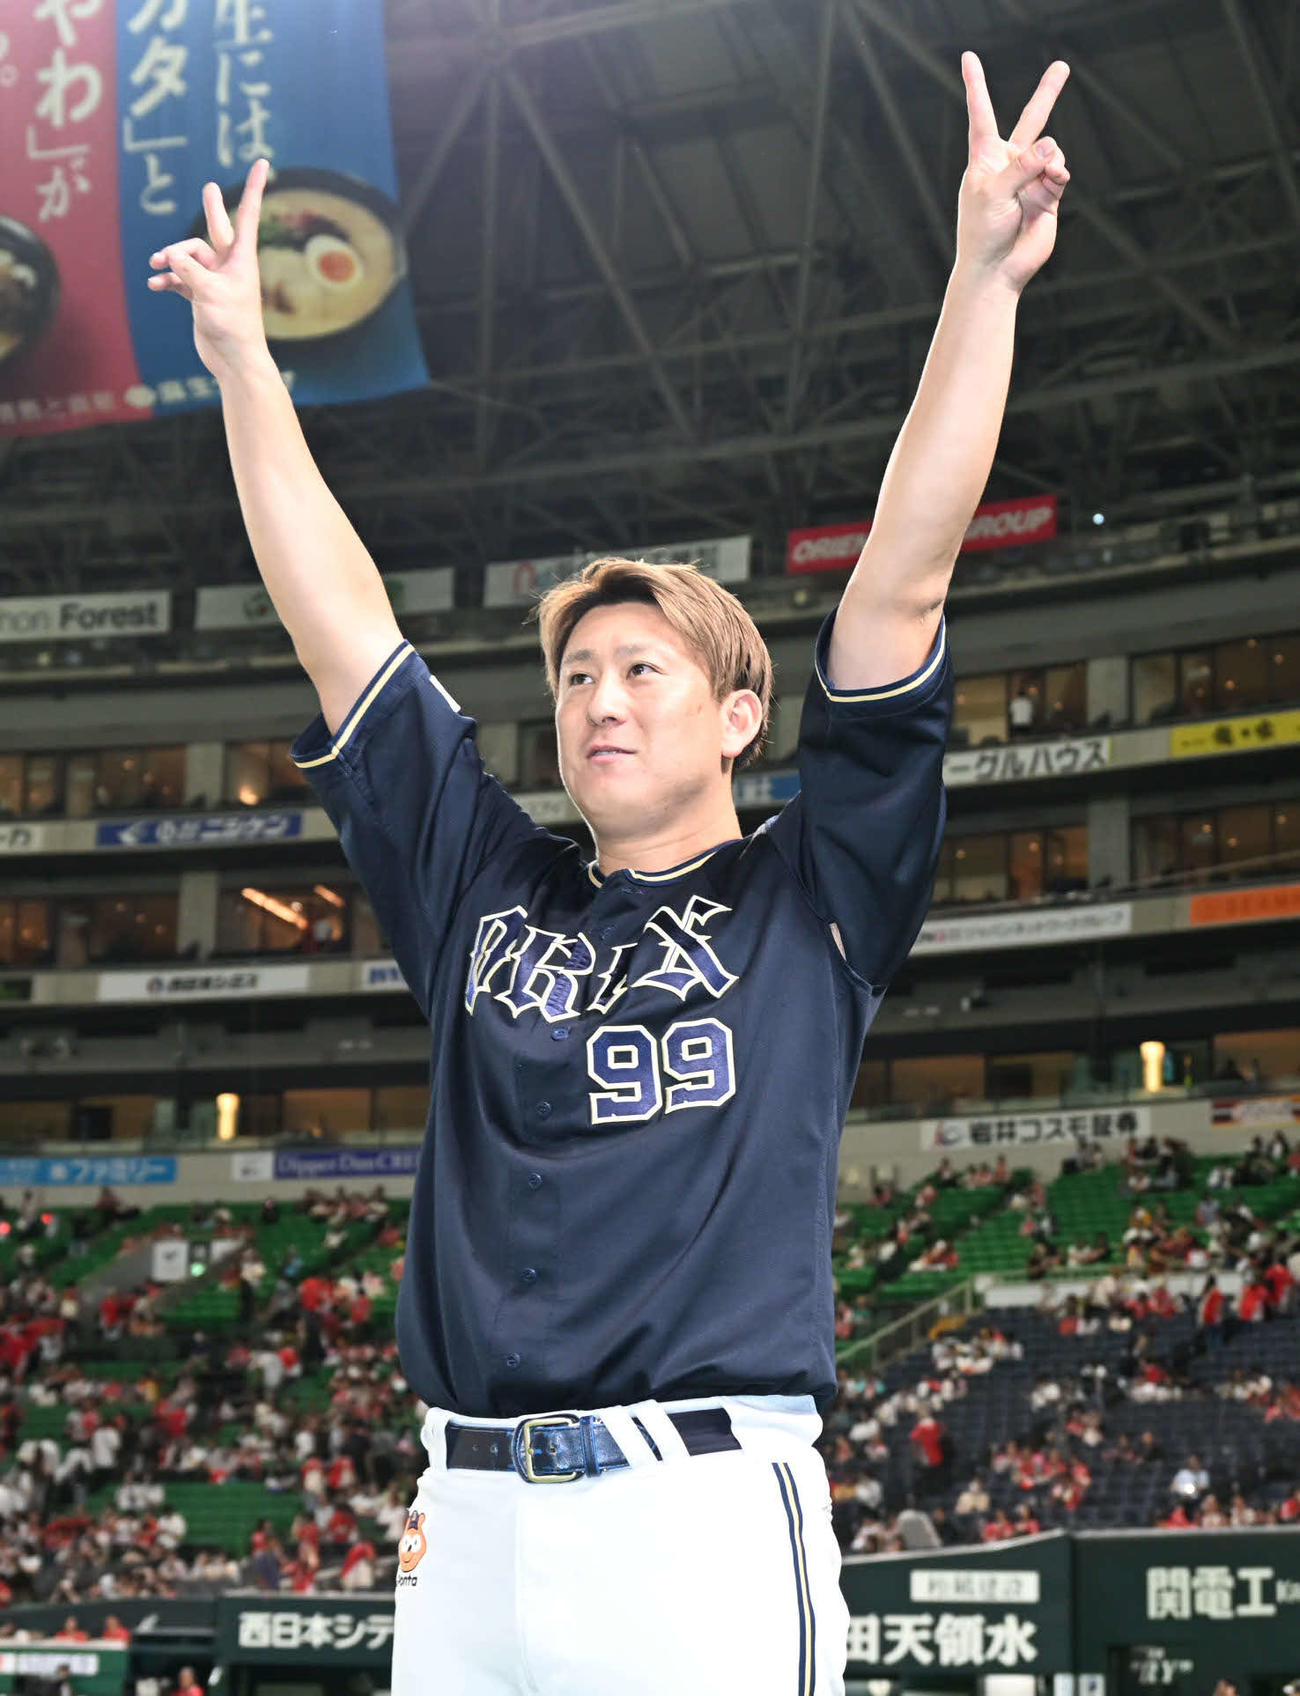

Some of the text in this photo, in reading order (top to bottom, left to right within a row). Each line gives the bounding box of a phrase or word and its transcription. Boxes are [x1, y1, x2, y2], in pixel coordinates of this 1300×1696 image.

[59, 602, 157, 629] Forest
[943, 740, 1105, 782] ーグルハウス
[465, 895, 739, 1023] ORIX
[586, 1017, 736, 1125] 99
[397, 1574, 418, 1587] onta
[1146, 1565, 1277, 1620] 関電工
